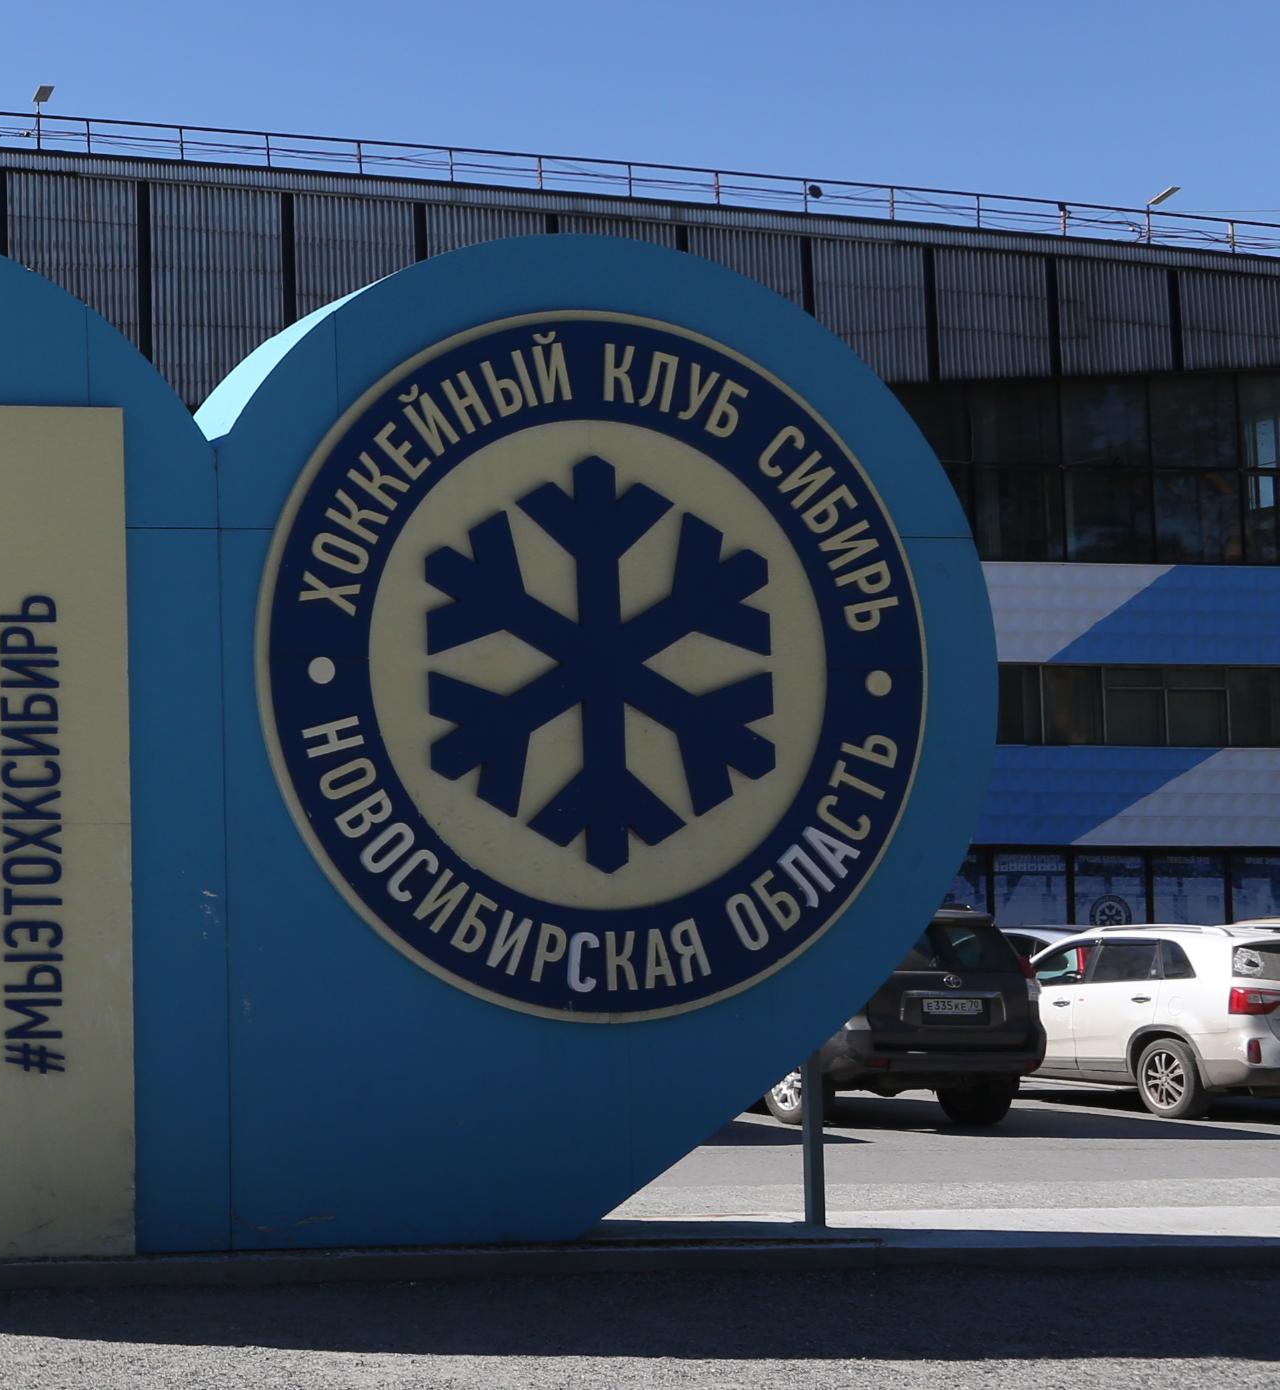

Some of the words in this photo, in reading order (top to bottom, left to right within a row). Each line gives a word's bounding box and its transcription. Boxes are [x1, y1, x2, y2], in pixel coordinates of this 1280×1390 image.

[299, 331, 573, 616] ХОККЕЙНЫЙ
[603, 343, 749, 438] КЛУБ
[758, 425, 900, 632] СИБИРЬ
[301, 716, 713, 992] НОВОСИБИРСКАЯ
[725, 733, 900, 951] ОБЛАСТЬ
